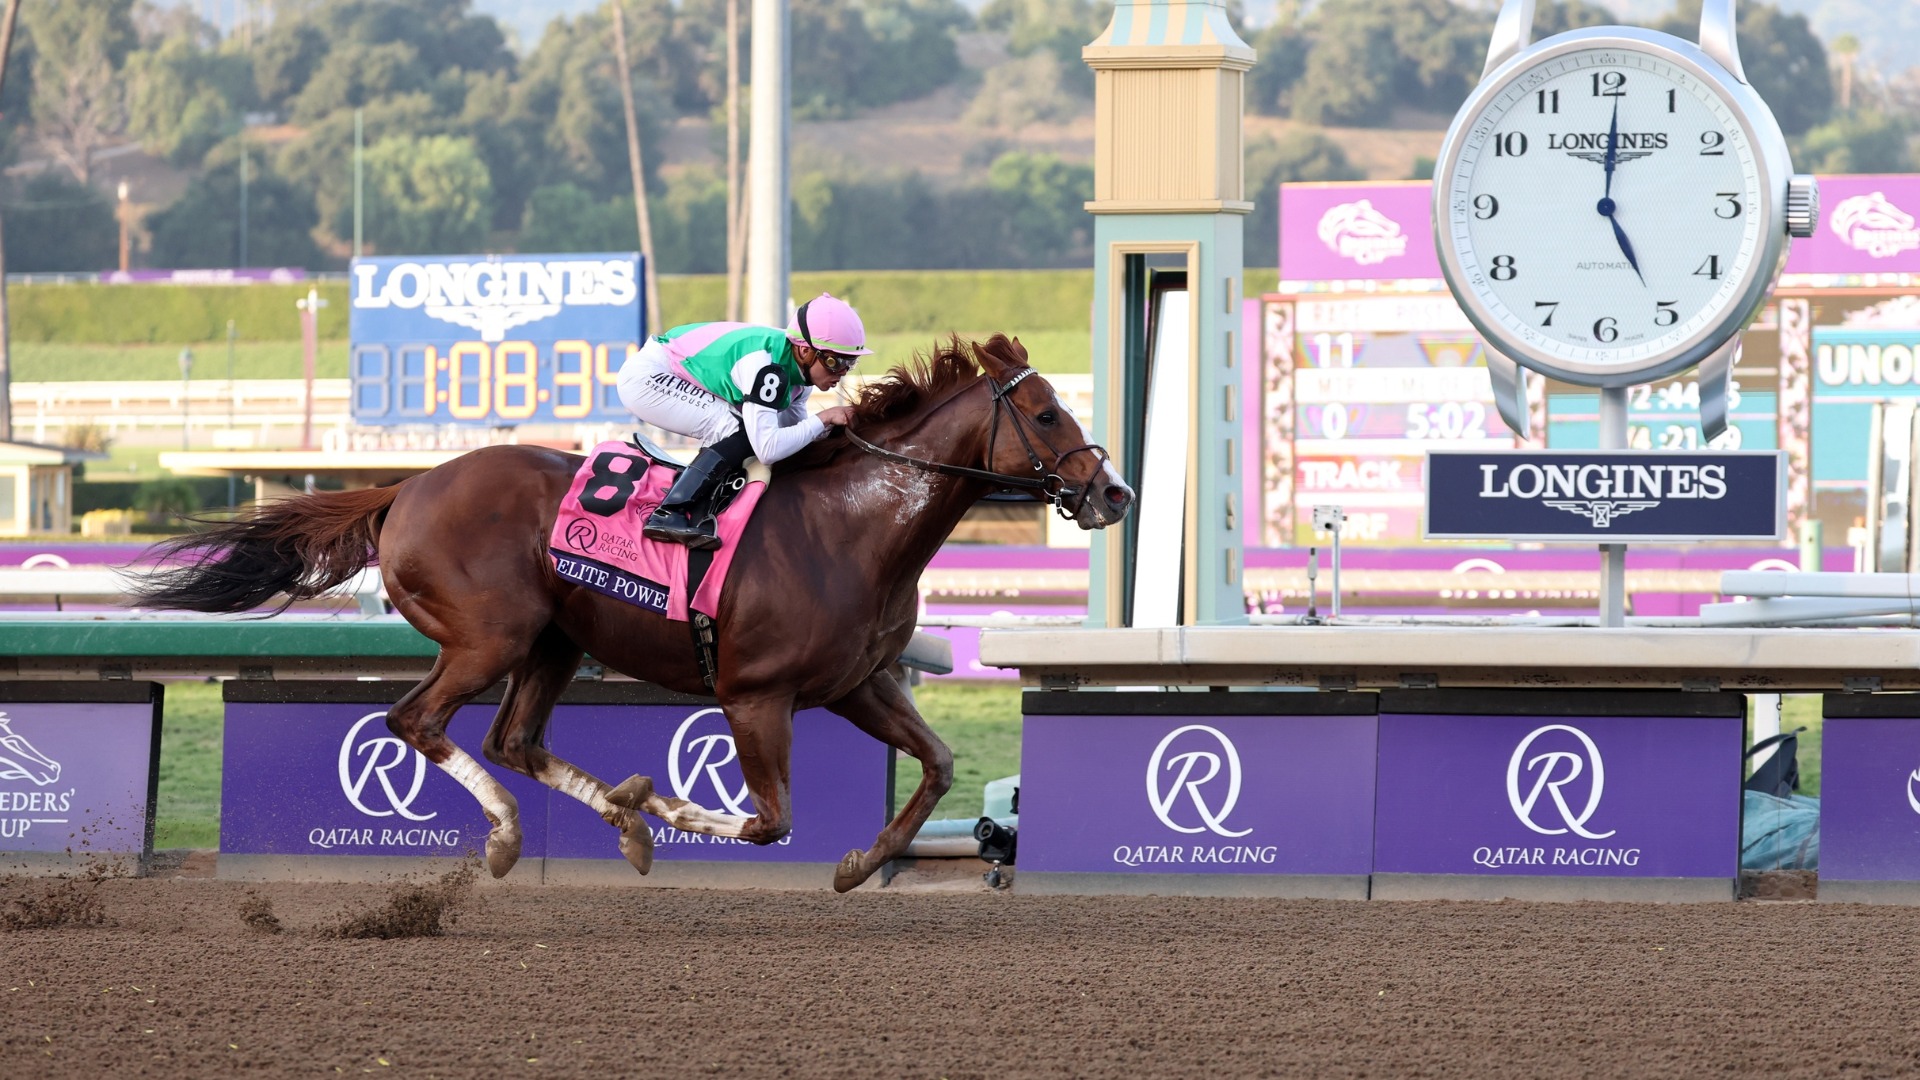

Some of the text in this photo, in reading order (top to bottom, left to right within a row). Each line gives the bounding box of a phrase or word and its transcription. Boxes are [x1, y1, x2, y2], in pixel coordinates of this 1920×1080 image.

[1590, 71, 1627, 97] 12
[1535, 89, 1559, 114] 11
[1666, 88, 1676, 113] 1
[1493, 131, 1528, 157] 10
[1548, 132, 1668, 150] LONGINES
[1699, 130, 1724, 156] 2
[1473, 193, 1499, 220] 9
[1714, 192, 1742, 219] 3
[1489, 254, 1517, 281] 8
[1691, 254, 1723, 280] 4
[353, 259, 637, 308] LONGINES
[1535, 301, 1560, 327] 7
[1654, 300, 1679, 327] 5
[1593, 316, 1619, 343] 6
[1313, 332, 1353, 369] 11
[759, 372, 781, 403] 8
[1321, 402, 1486, 440] 0 5:02
[577, 452, 649, 518] 8
[1299, 460, 1401, 489] TRACK
[1479, 464, 1727, 500] LONGINES
[598, 543, 639, 562] RACING
[601, 532, 634, 549] QATAR
[556, 558, 670, 611] ELITE POWE
[309, 827, 460, 848] QATAR RACING
[1113, 845, 1277, 867] QATAR RACING
[1473, 846, 1641, 868] QATAR RACING
